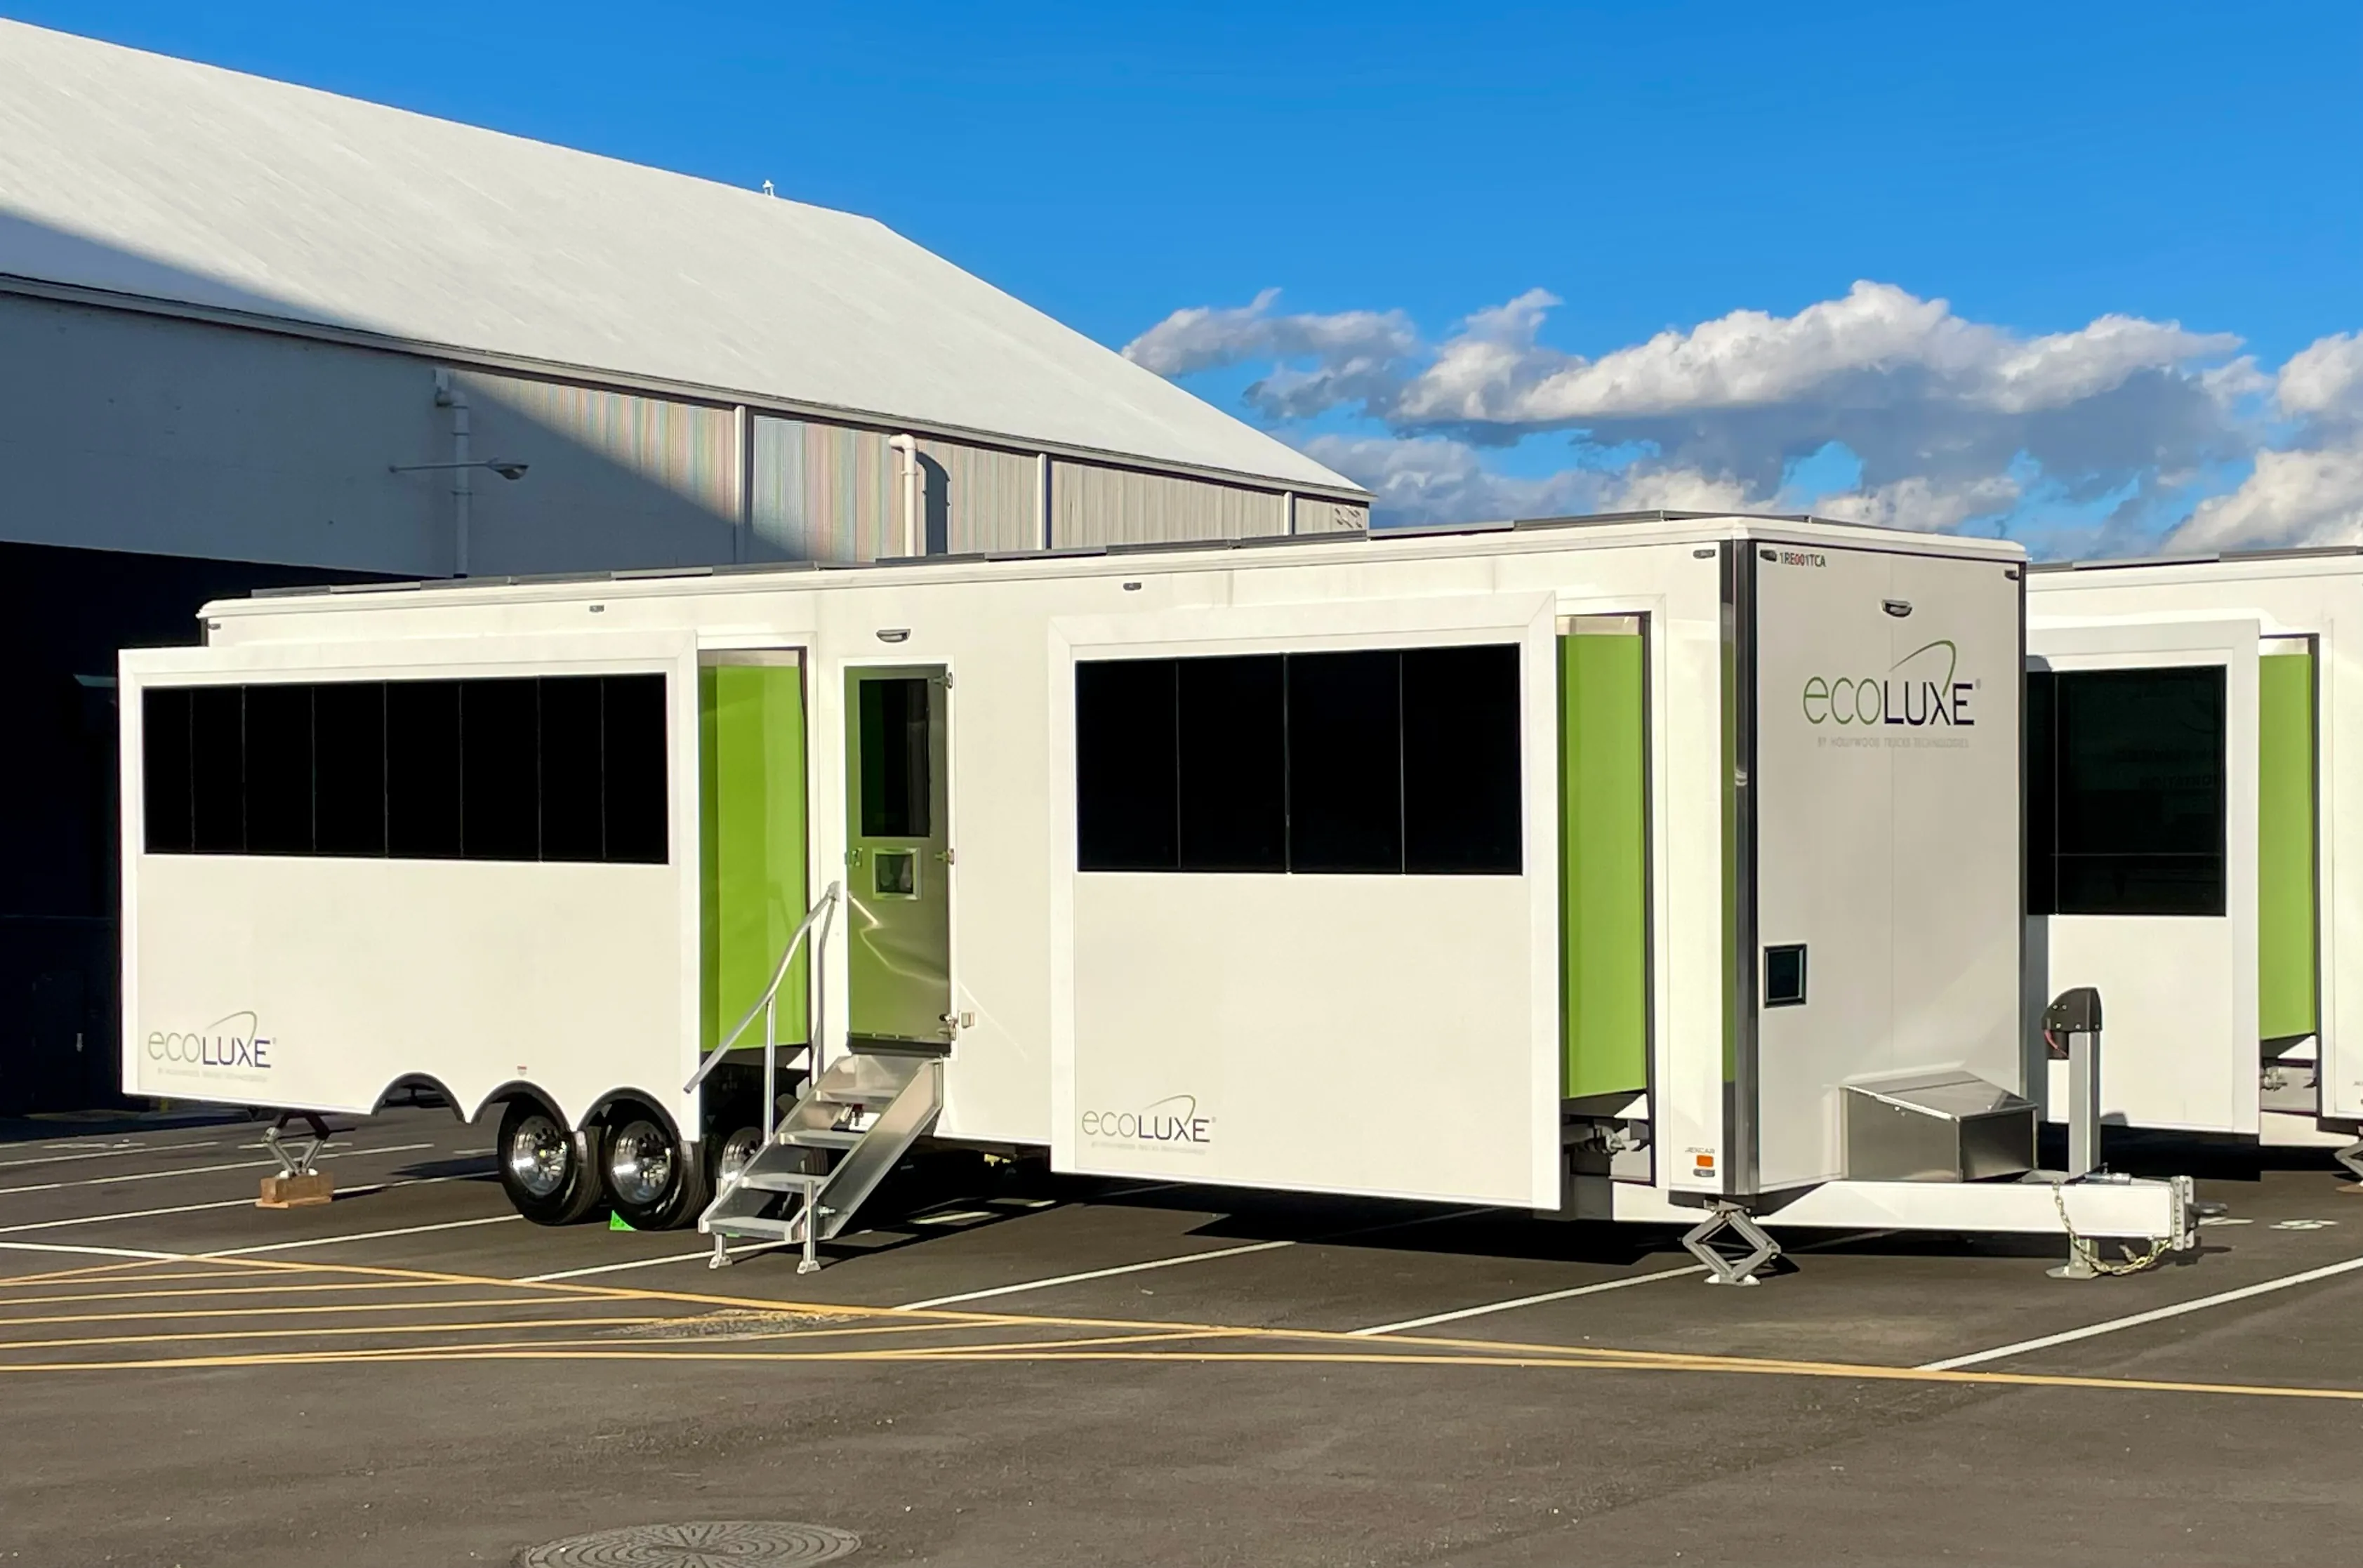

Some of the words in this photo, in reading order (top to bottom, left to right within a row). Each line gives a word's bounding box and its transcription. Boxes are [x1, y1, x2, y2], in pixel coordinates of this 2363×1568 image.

[1802, 675, 1975, 726] ecoLUXE
[147, 1030, 272, 1069] ecoLUXE
[1081, 1109, 1211, 1143] ecoLUXE
